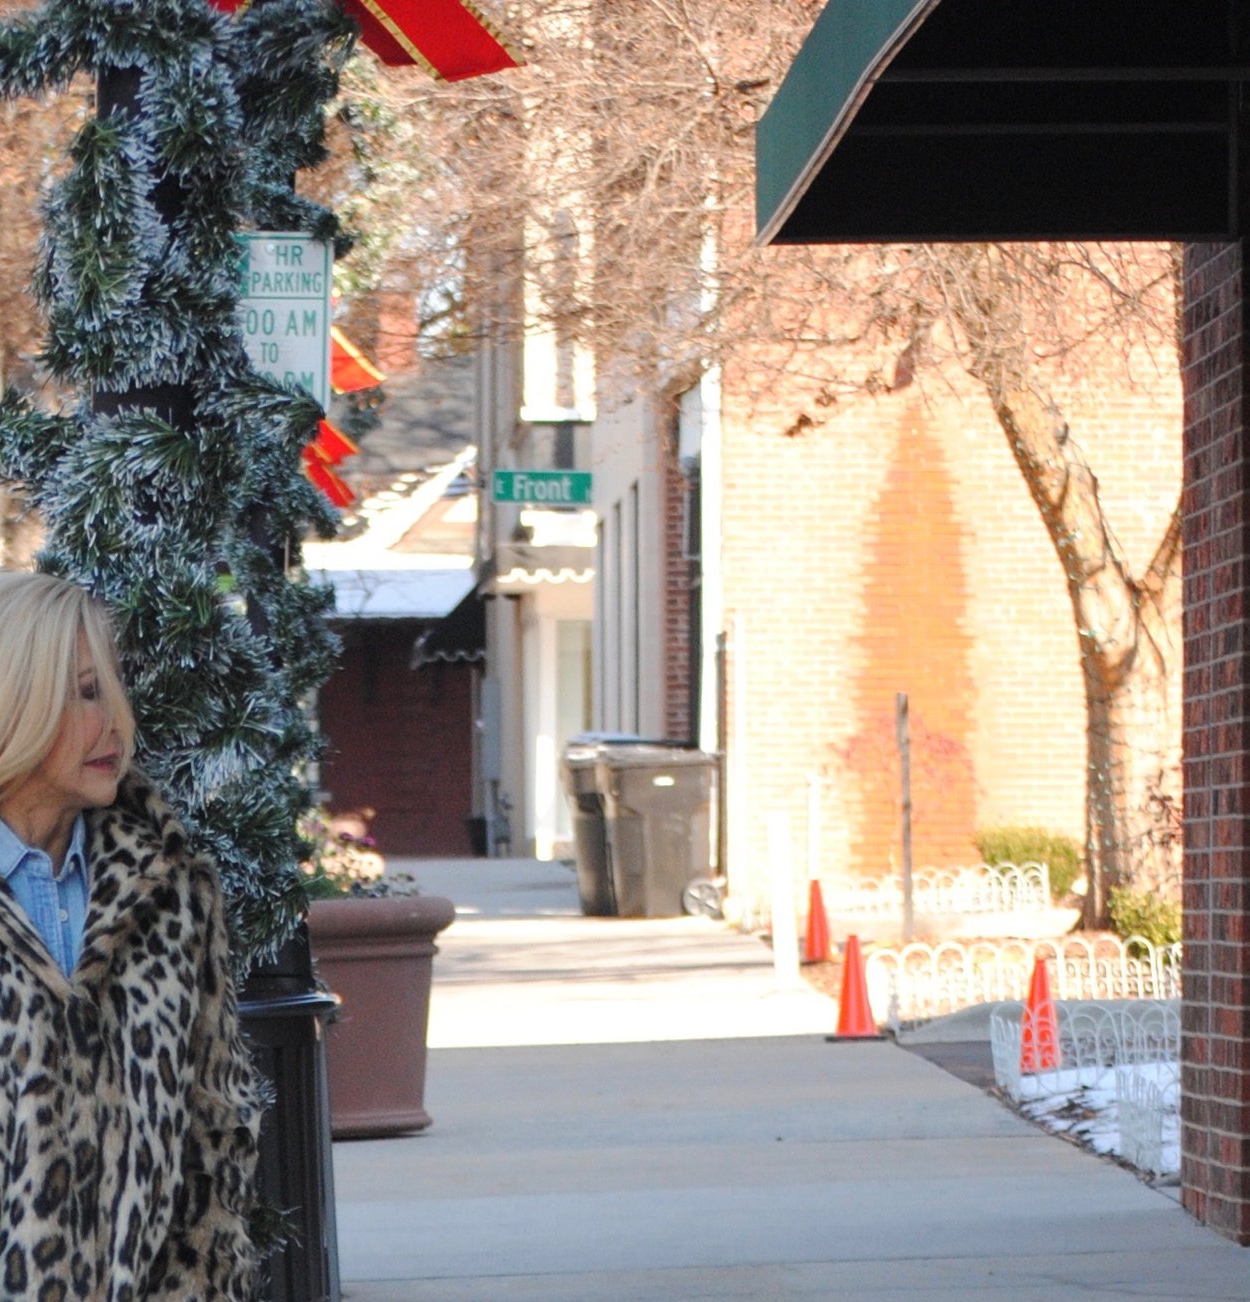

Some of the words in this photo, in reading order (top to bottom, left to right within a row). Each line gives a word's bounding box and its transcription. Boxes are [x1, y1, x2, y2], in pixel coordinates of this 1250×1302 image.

[276, 245, 303, 266] HR
[252, 272, 322, 293] PARKING
[246, 309, 274, 335] 00
[285, 310, 316, 336] AM
[261, 342, 279, 363] TO
[513, 474, 572, 500] Front
